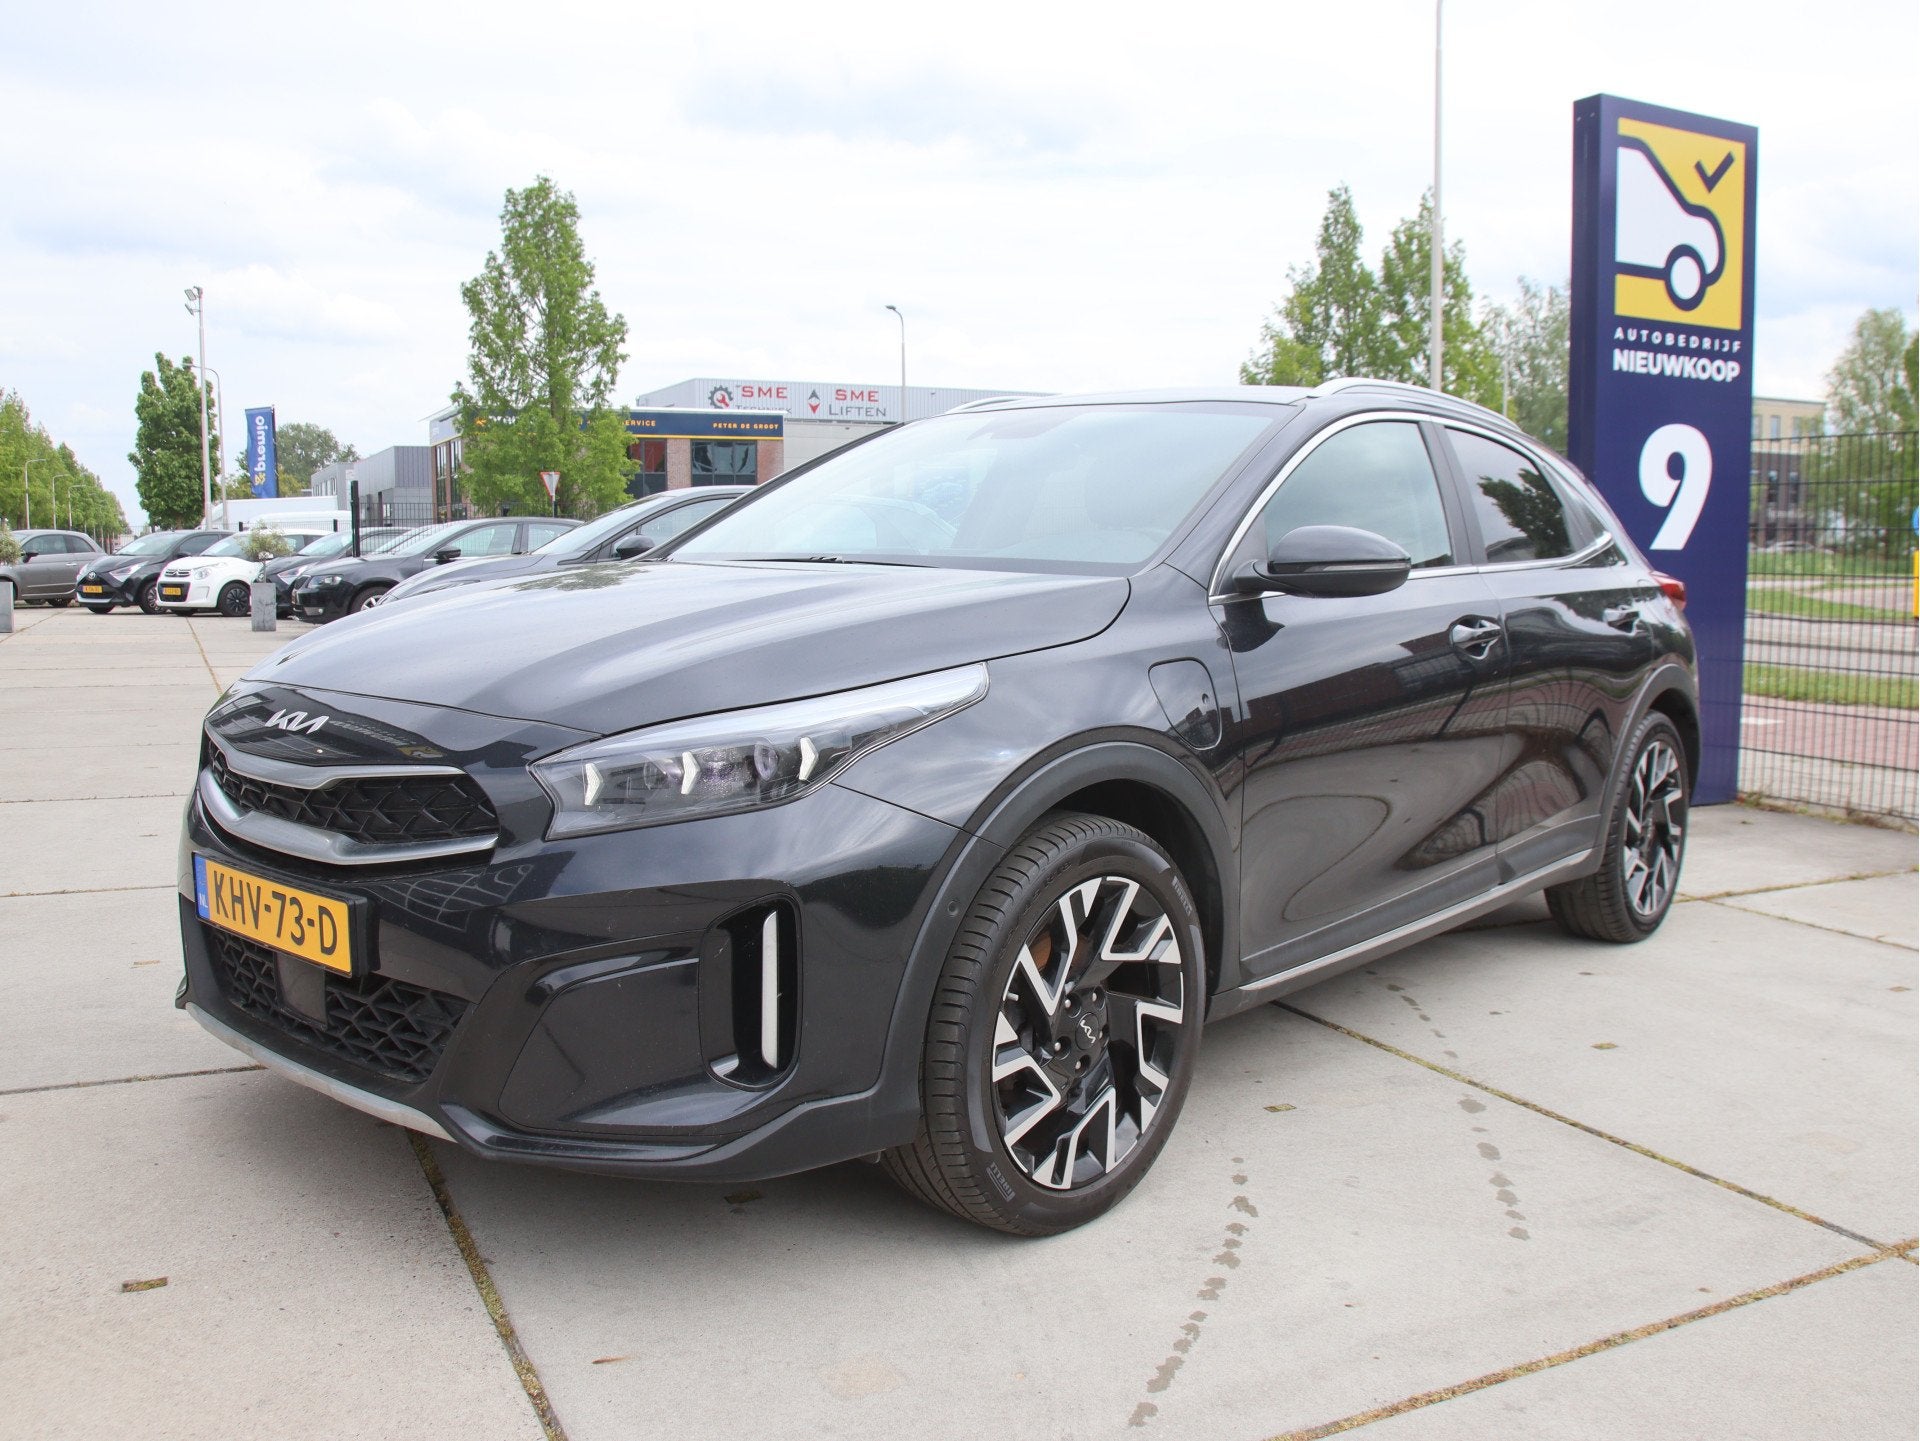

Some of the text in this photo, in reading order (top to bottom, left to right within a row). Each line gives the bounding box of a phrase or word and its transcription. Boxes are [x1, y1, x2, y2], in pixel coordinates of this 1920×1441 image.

[1614, 326, 1742, 353] AUTOBEDRIJF
[1613, 348, 1741, 382] NIEUWKOOP
[741, 385, 788, 399] SME
[835, 389, 879, 402] SME
[828, 404, 887, 417] LIFTEN
[622, 419, 656, 427] ERVICE
[1639, 423, 1713, 550] 9
[198, 893, 209, 909] NL
[213, 870, 338, 956] KHV-73-D
